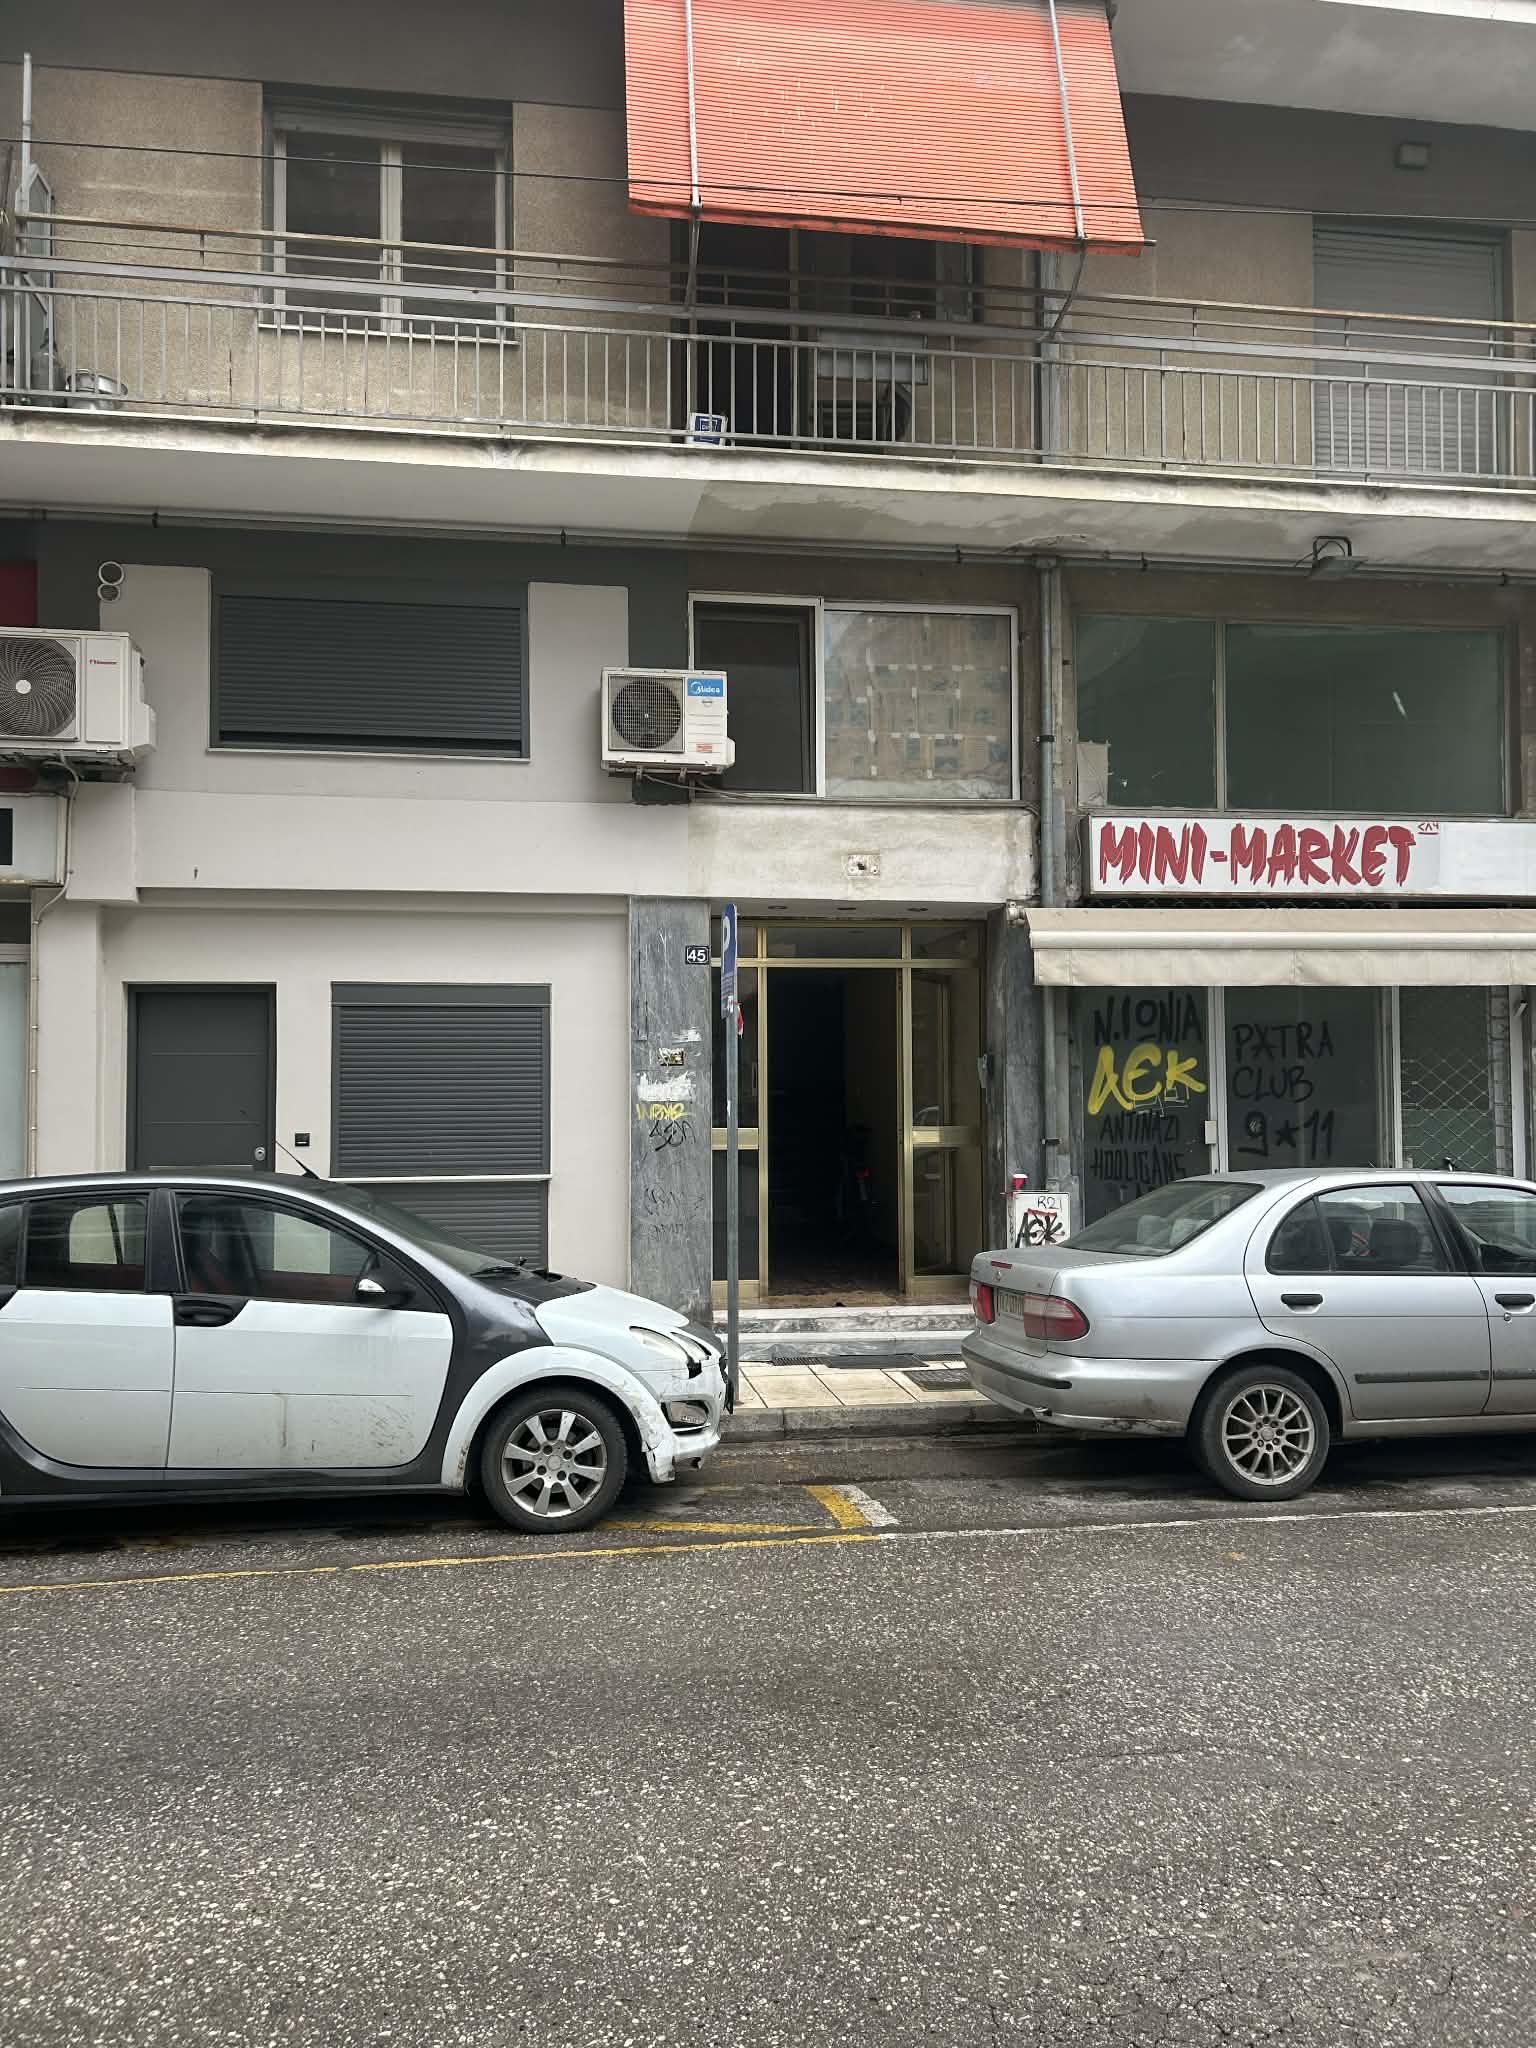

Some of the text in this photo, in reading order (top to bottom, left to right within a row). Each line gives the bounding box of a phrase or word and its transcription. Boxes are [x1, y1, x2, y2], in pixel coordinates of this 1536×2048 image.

[1099, 821, 1416, 888] MINI-MARKET
[687, 949, 706, 962] 45
[1232, 1065, 1313, 1104] CLUB
